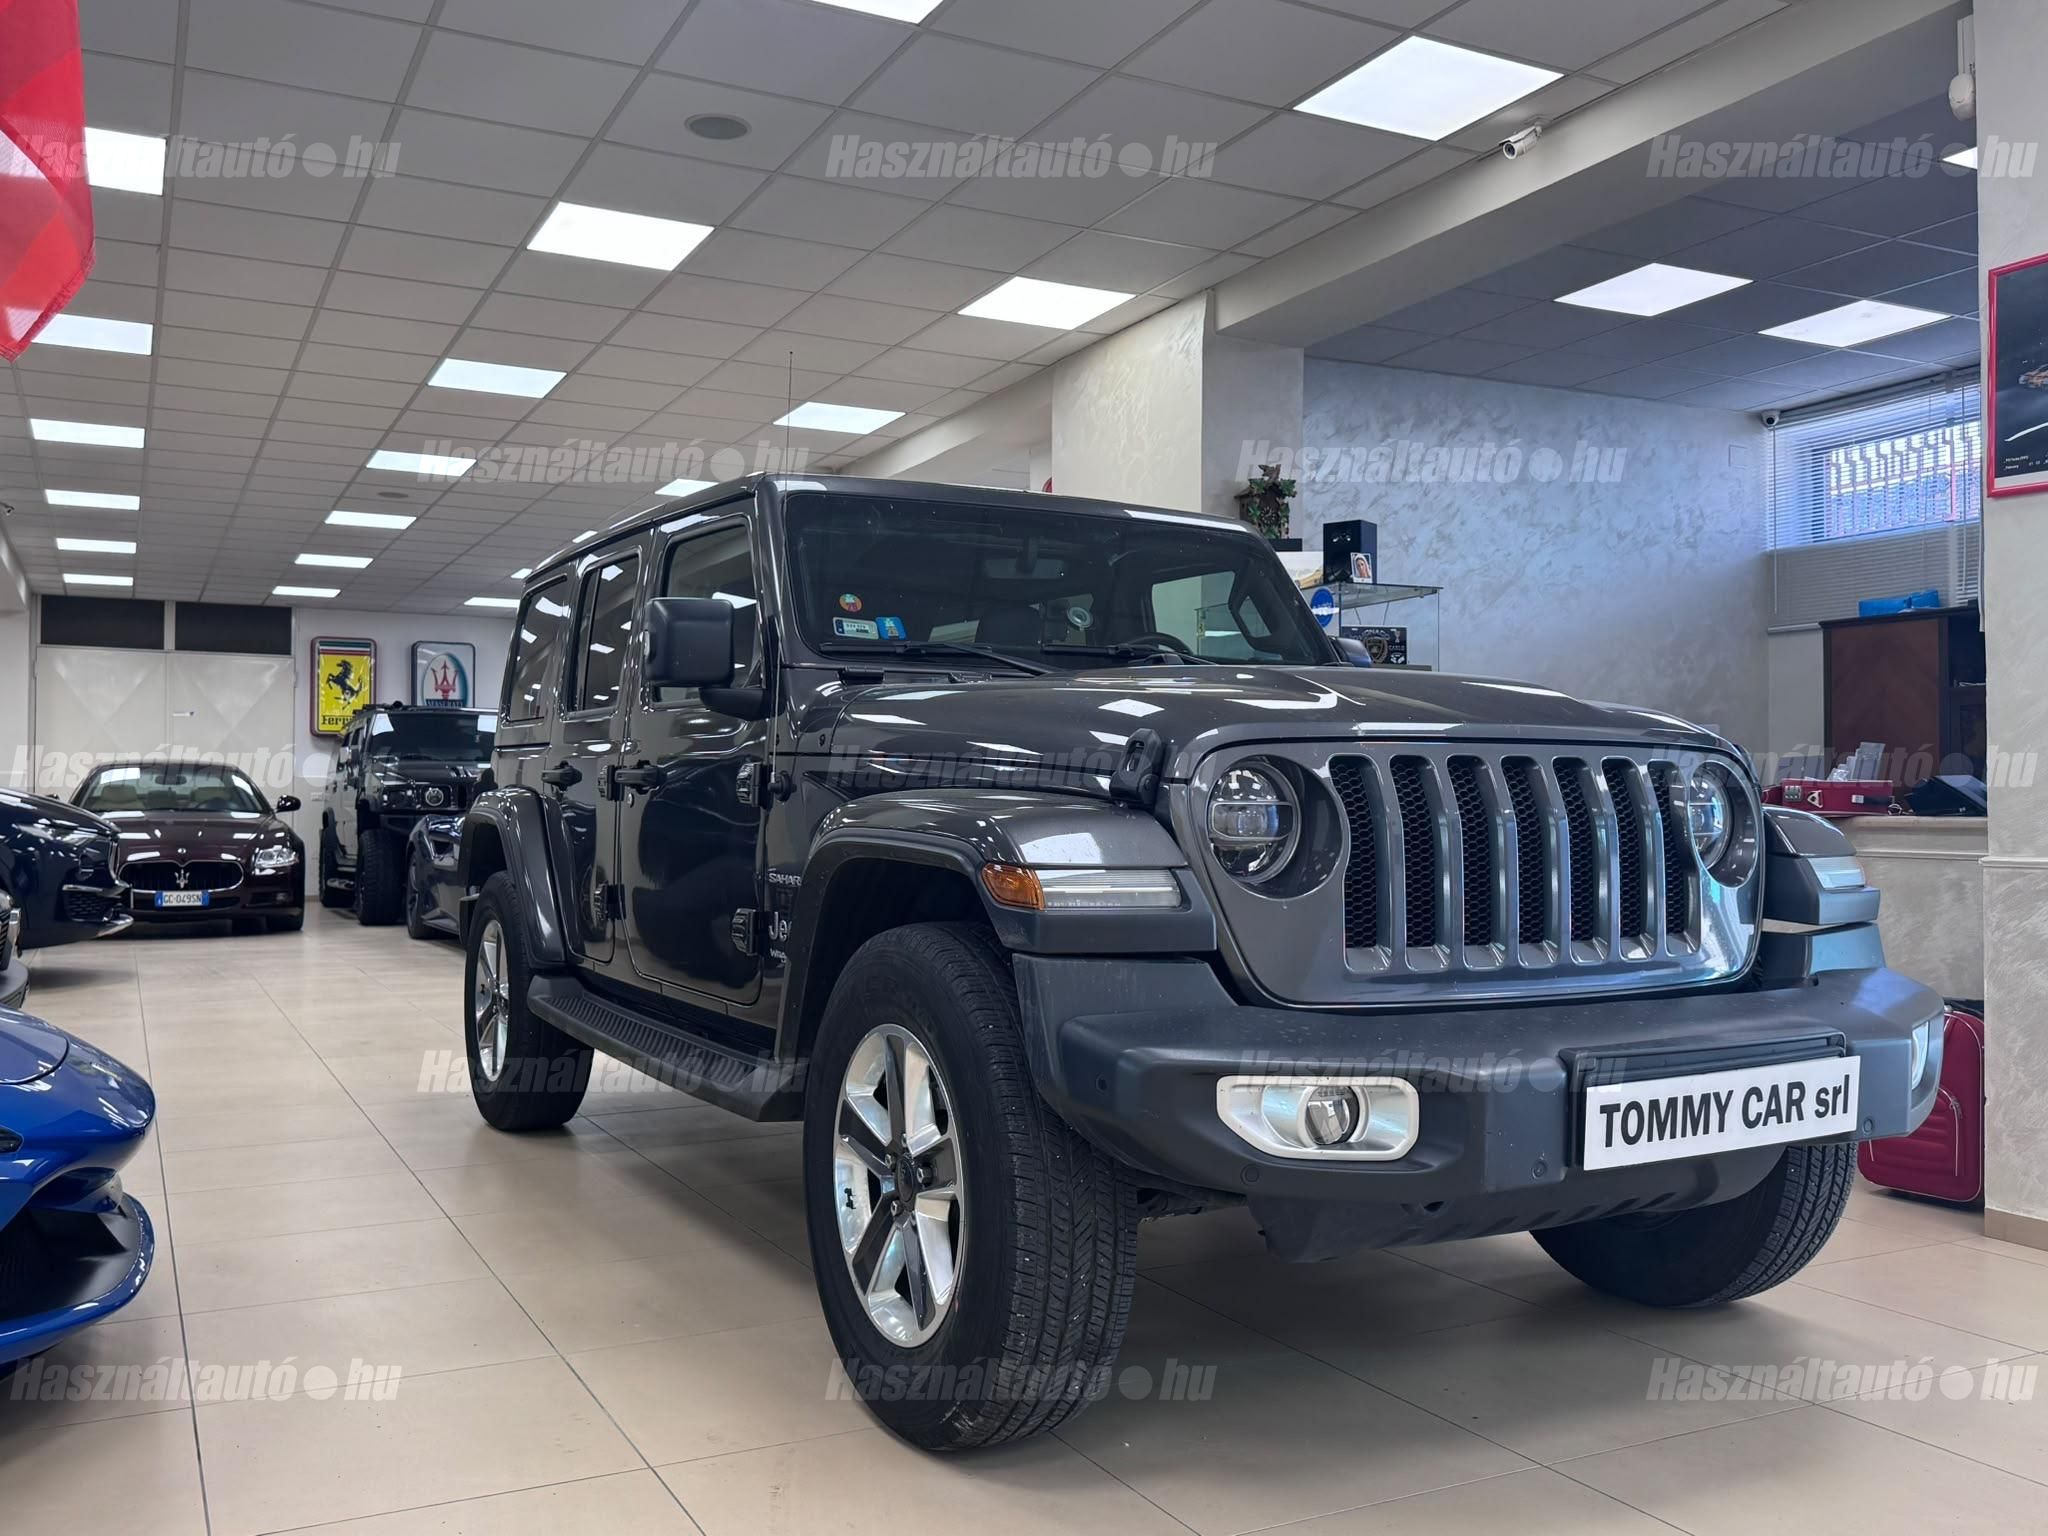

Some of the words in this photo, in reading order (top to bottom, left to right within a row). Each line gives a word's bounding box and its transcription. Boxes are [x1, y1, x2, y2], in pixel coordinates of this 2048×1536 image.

[321, 715, 353, 725] Ferr
[768, 872, 802, 886] SAHAR
[769, 911, 792, 940] Je
[1600, 1089, 1734, 1148] TOMMY
[1742, 1080, 1806, 1129] CAR
[1814, 1074, 1850, 1119] srl
